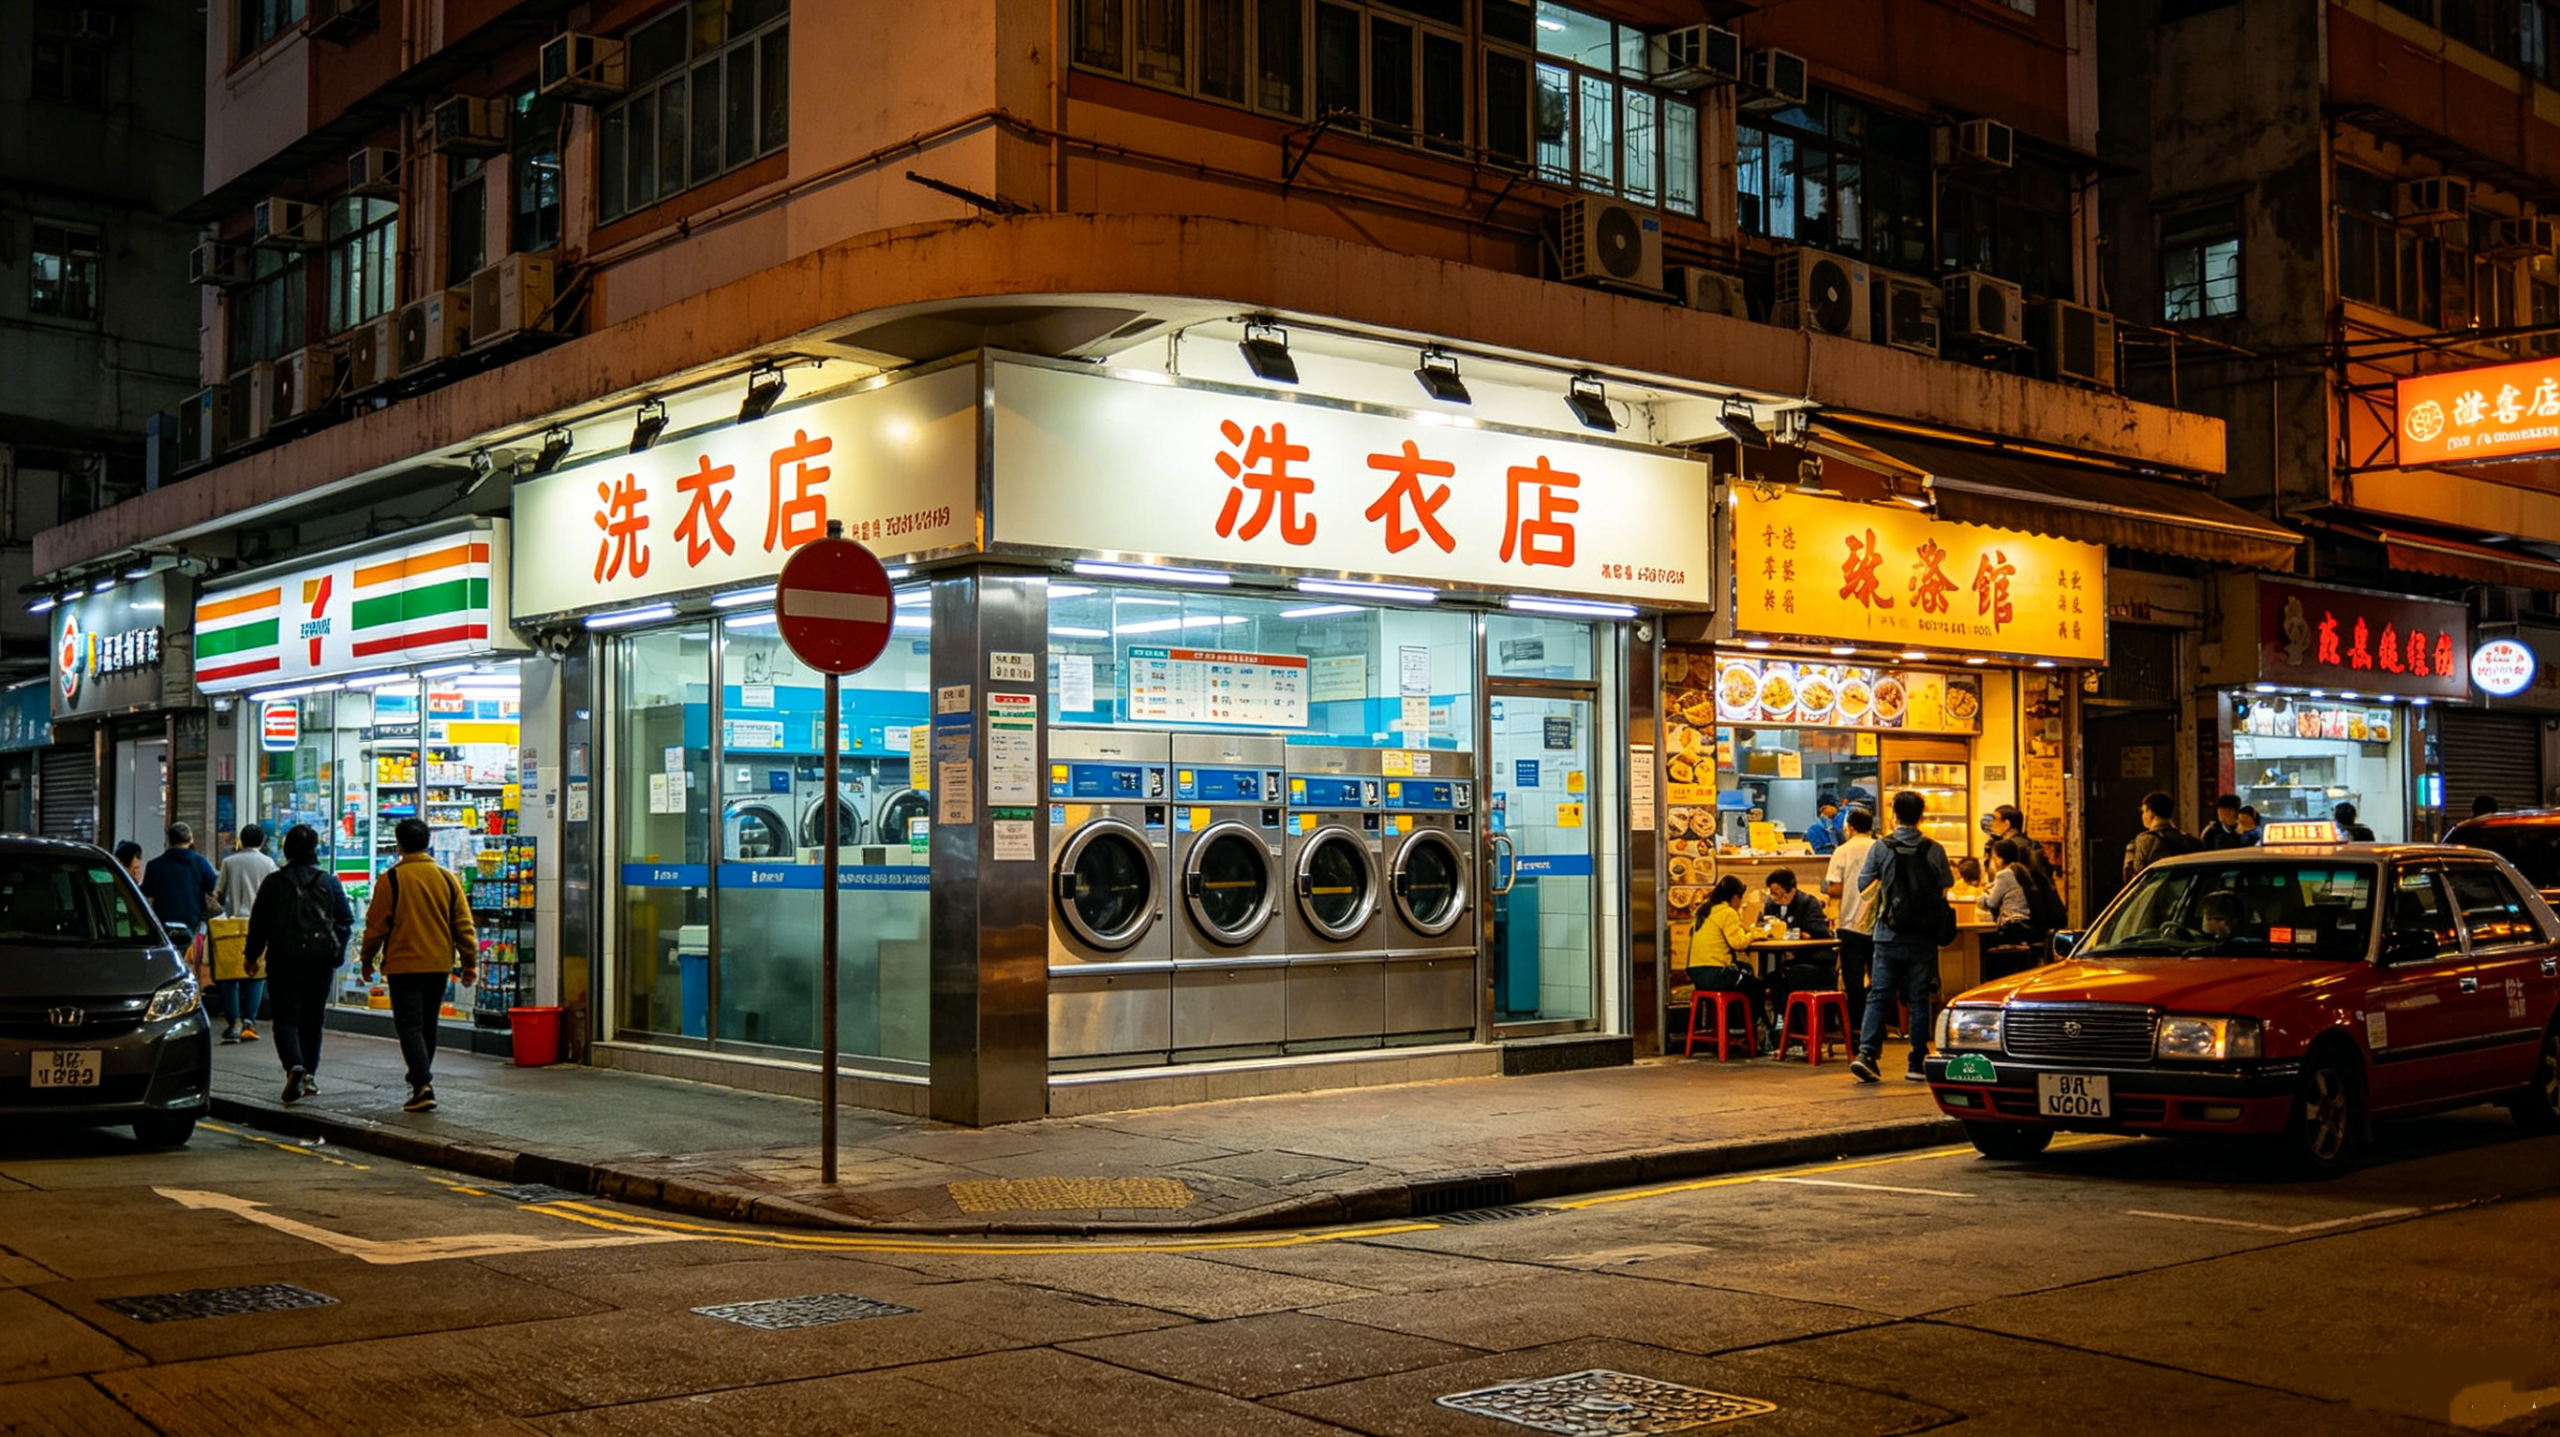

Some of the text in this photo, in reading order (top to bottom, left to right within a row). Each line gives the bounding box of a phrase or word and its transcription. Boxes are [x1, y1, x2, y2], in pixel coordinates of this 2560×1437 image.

[594, 428, 834, 584] 洗衣店
[1214, 418, 1581, 568] 洗衣店
